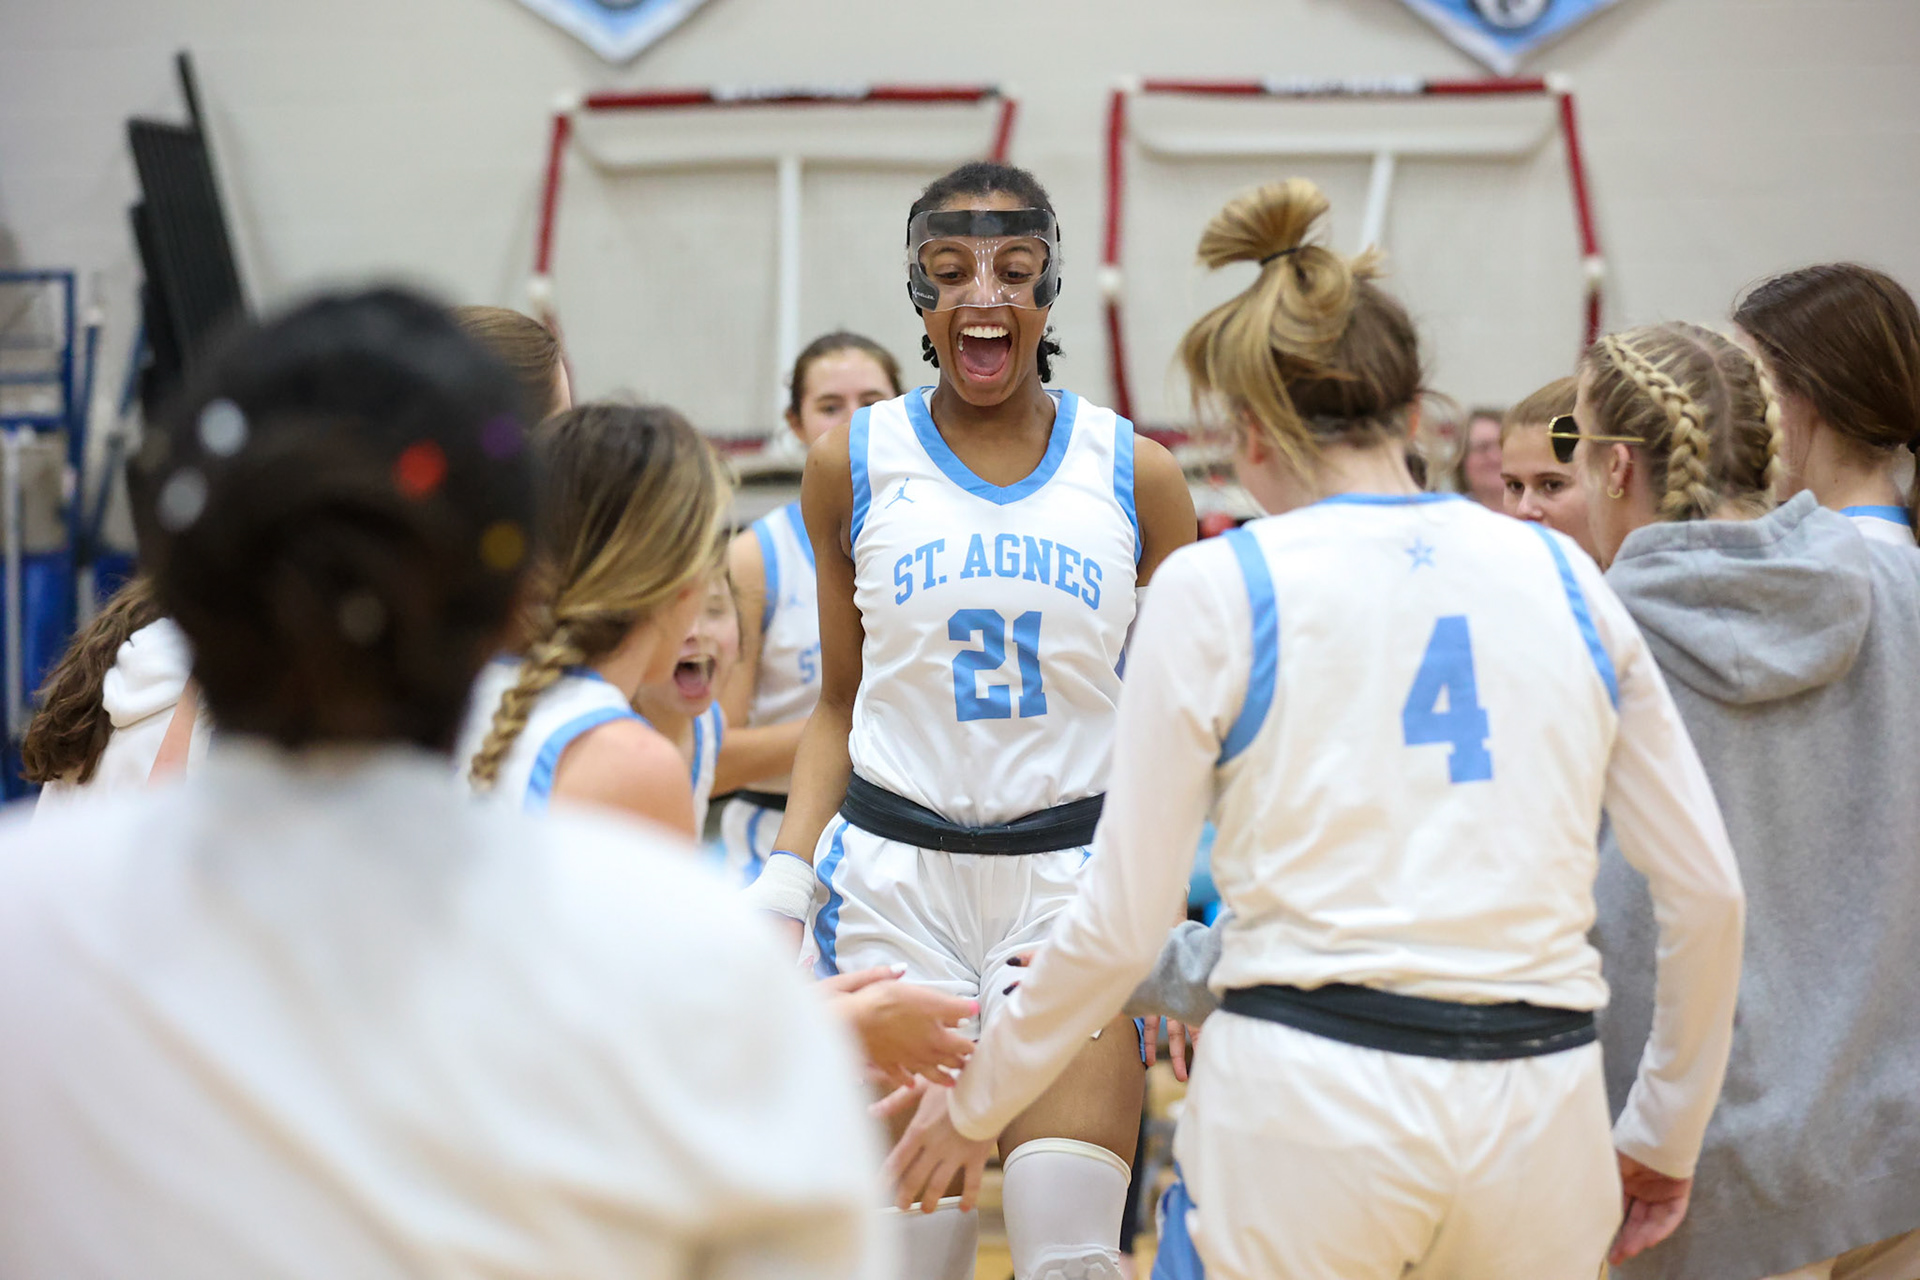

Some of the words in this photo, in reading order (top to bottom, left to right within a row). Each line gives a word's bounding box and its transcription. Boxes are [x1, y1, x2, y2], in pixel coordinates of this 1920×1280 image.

[893, 538, 947, 606] ST.
[960, 533, 1103, 610] AGNES
[797, 642, 820, 684] S
[947, 608, 1048, 722] 21
[1401, 614, 1494, 784] 4
